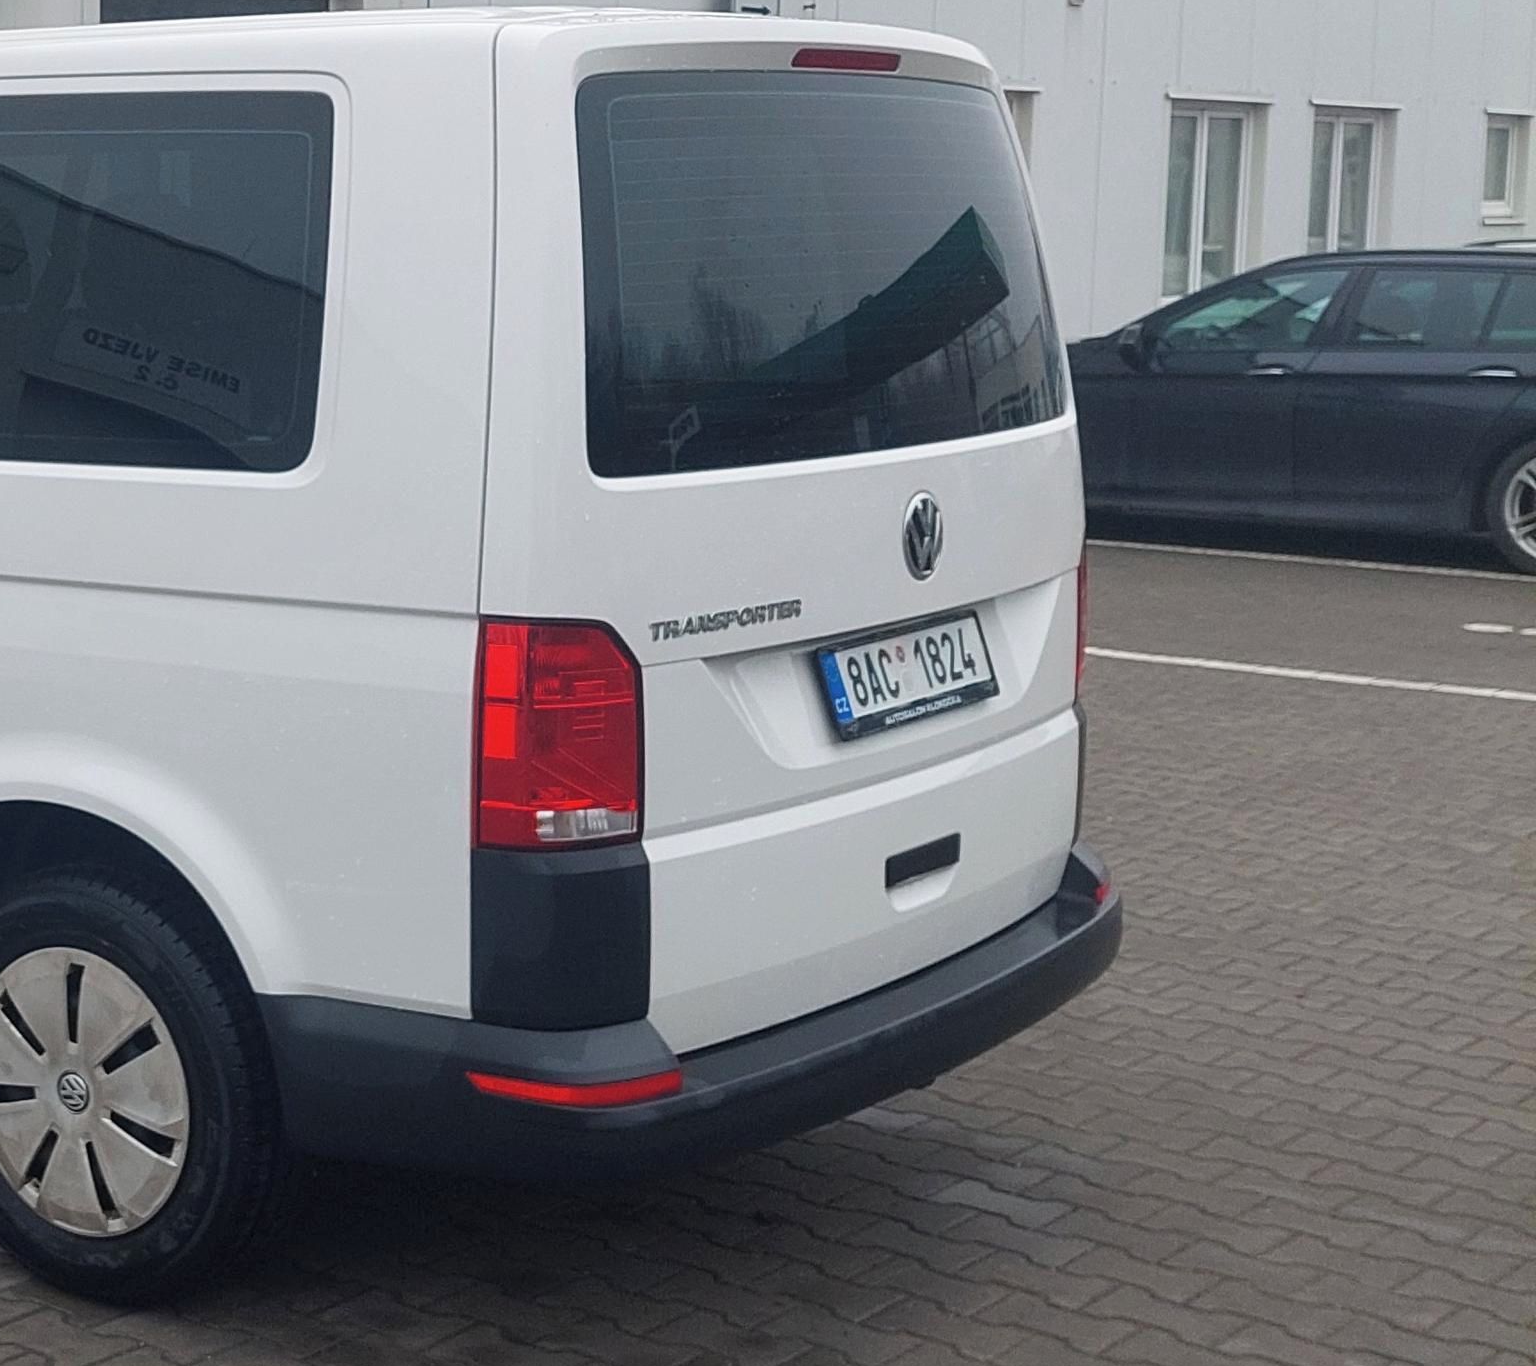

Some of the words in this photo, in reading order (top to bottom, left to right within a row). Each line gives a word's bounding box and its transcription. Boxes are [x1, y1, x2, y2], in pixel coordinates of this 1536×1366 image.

[649, 598, 802, 643] TRANSPORTER
[846, 648, 900, 707] 8AC
[913, 627, 977, 689] 1824
[835, 696, 850, 714] CZ
